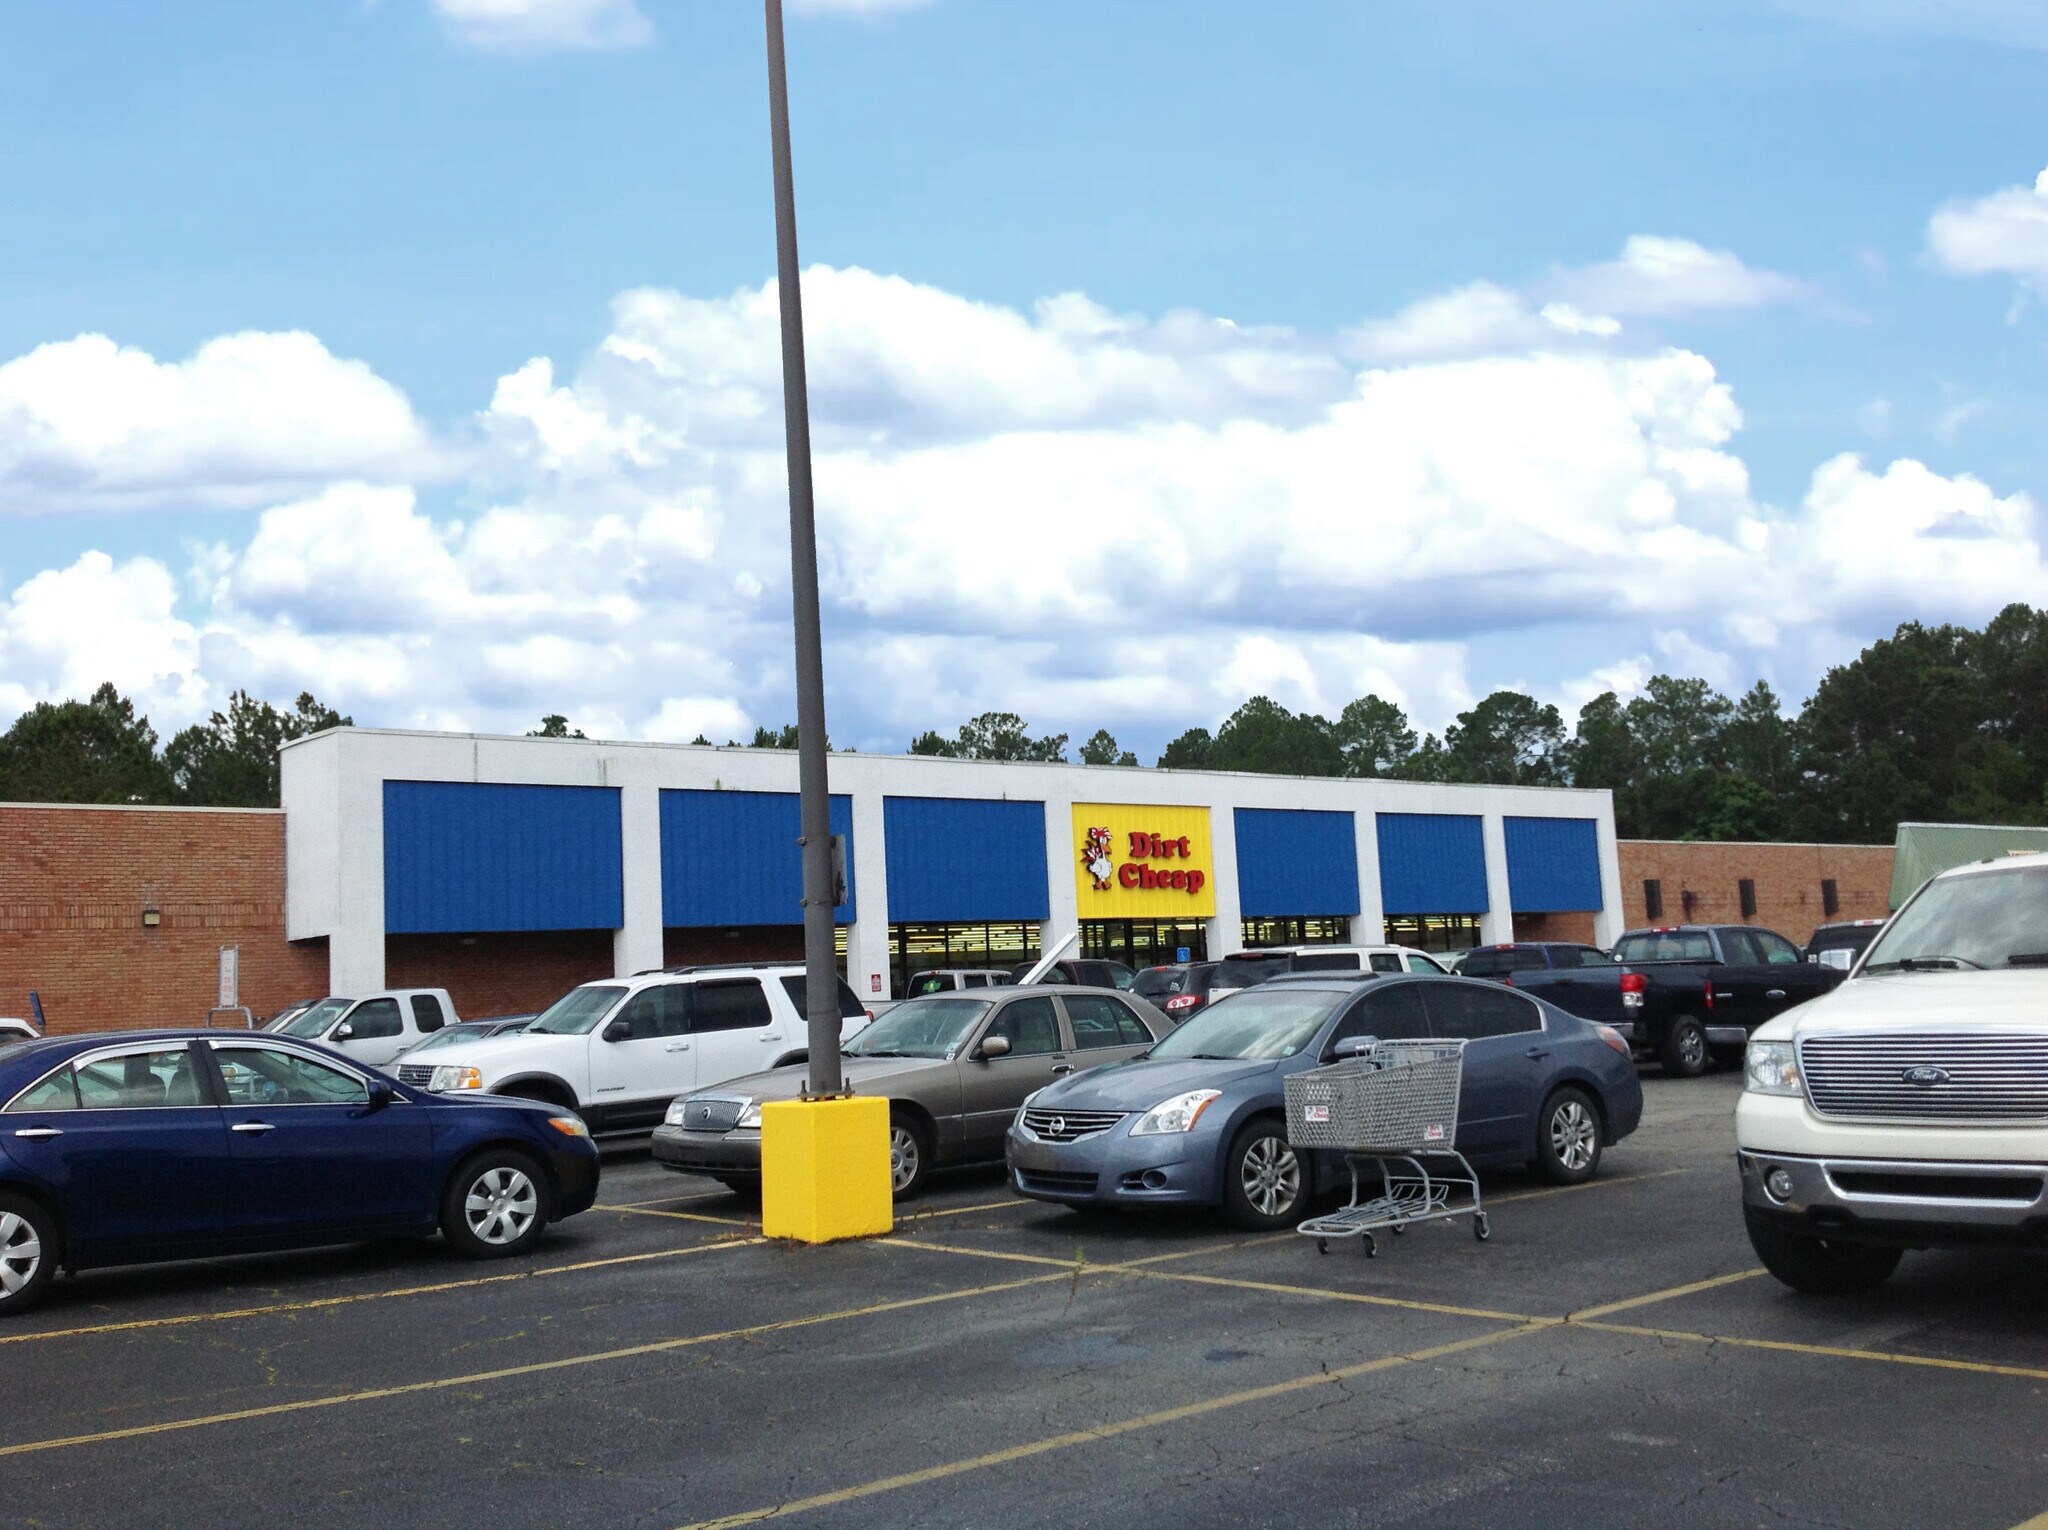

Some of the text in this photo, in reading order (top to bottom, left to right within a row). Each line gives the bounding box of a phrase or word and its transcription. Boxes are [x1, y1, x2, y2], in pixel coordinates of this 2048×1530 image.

[1128, 832, 1191, 858] Dirt
[1118, 863, 1205, 894] Cheap
[1911, 1069, 1938, 1081] Ford
